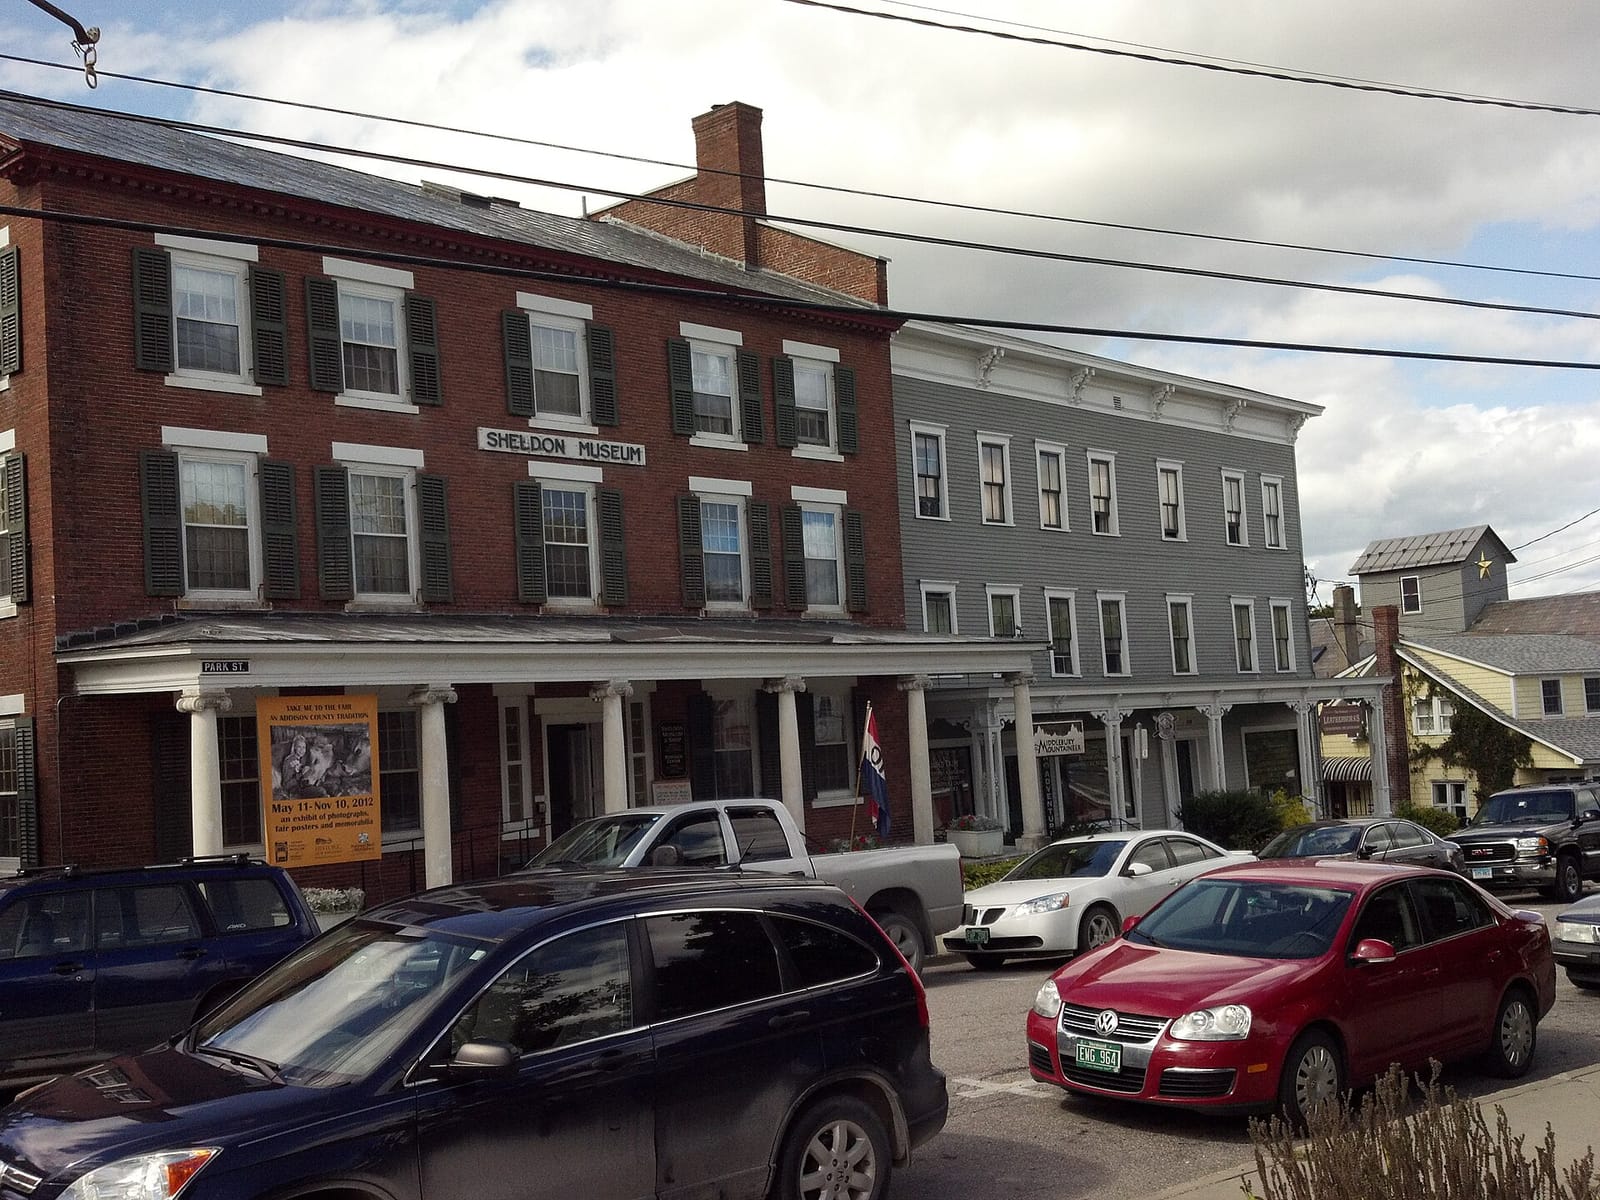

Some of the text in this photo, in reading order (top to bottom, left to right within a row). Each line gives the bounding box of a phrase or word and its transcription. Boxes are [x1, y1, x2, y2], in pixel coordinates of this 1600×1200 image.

[487, 432, 641, 462] SHELDON MUSEUM
[204, 662, 246, 672] PARK ST.
[272, 804, 294, 814] May
[352, 797, 374, 808] 2012
[293, 814, 318, 822] exhibit
[291, 823, 319, 833] posters
[335, 819, 373, 828] memorabilia
[1100, 1050, 1116, 1065] 964
